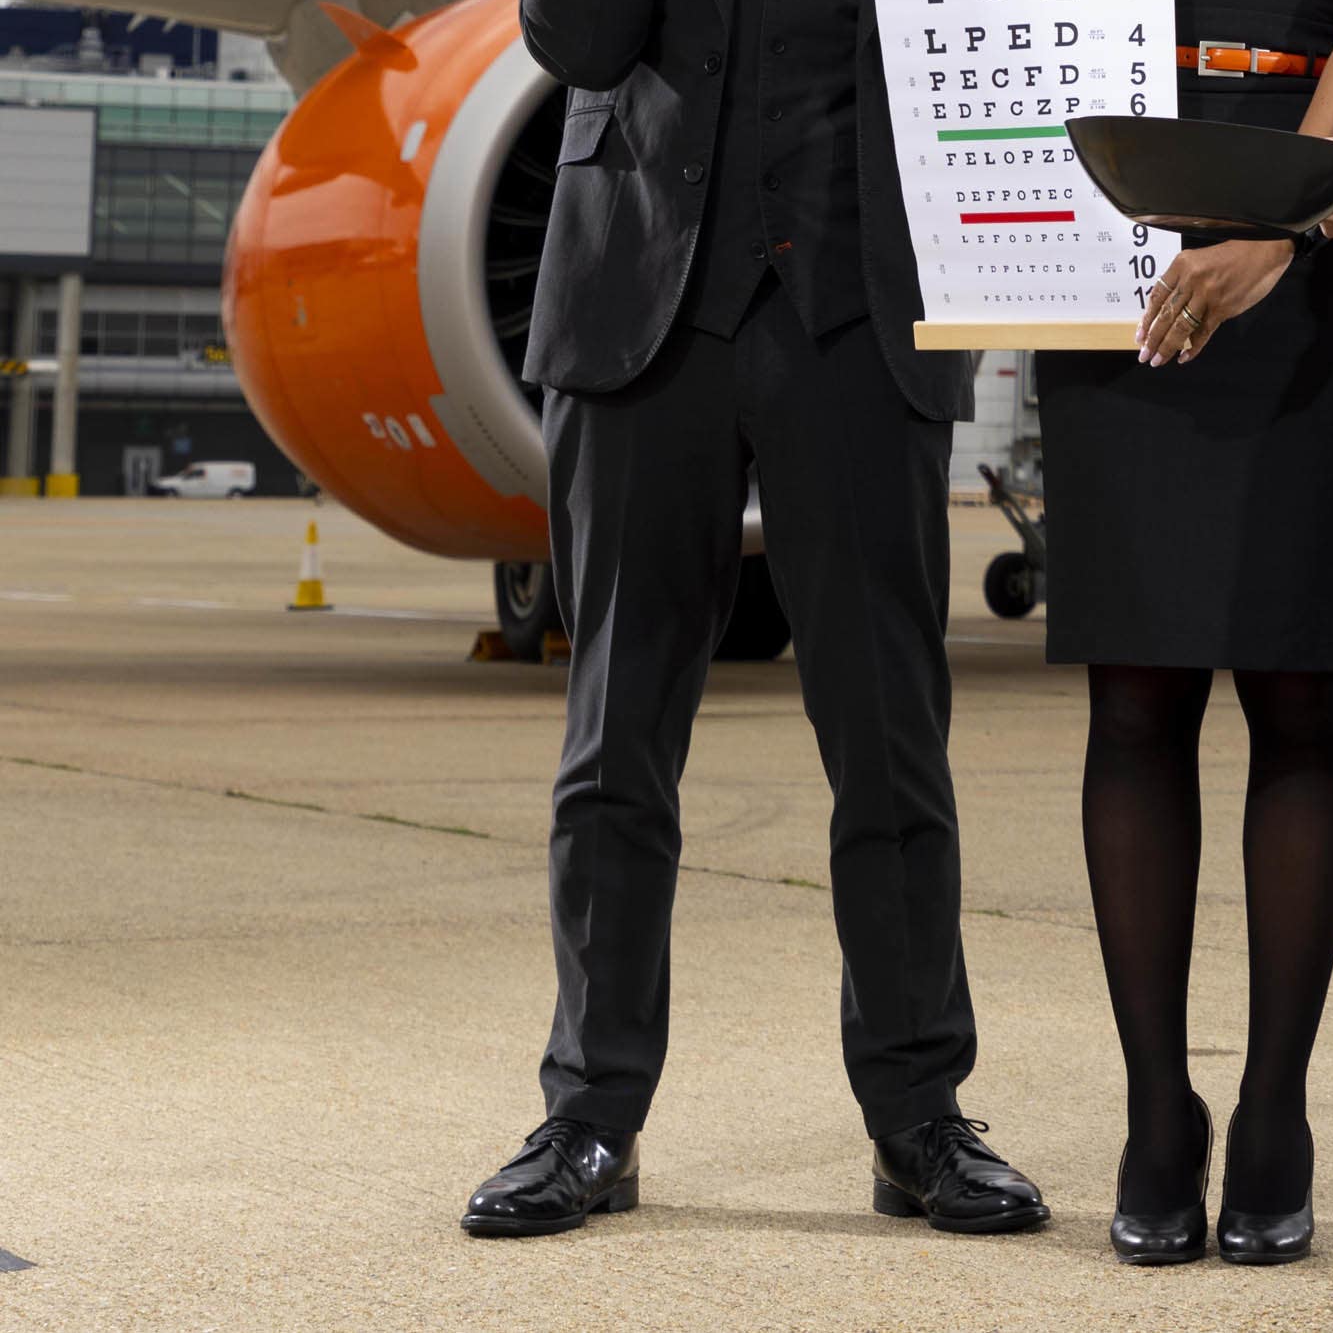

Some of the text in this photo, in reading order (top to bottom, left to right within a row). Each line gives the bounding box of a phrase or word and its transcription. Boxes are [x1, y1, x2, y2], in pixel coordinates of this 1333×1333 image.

[1128, 23, 1146, 46] 4
[1130, 62, 1146, 85] 5
[1130, 93, 1147, 116] 6
[1132, 224, 1149, 247] 9
[1129, 254, 1156, 279] 10
